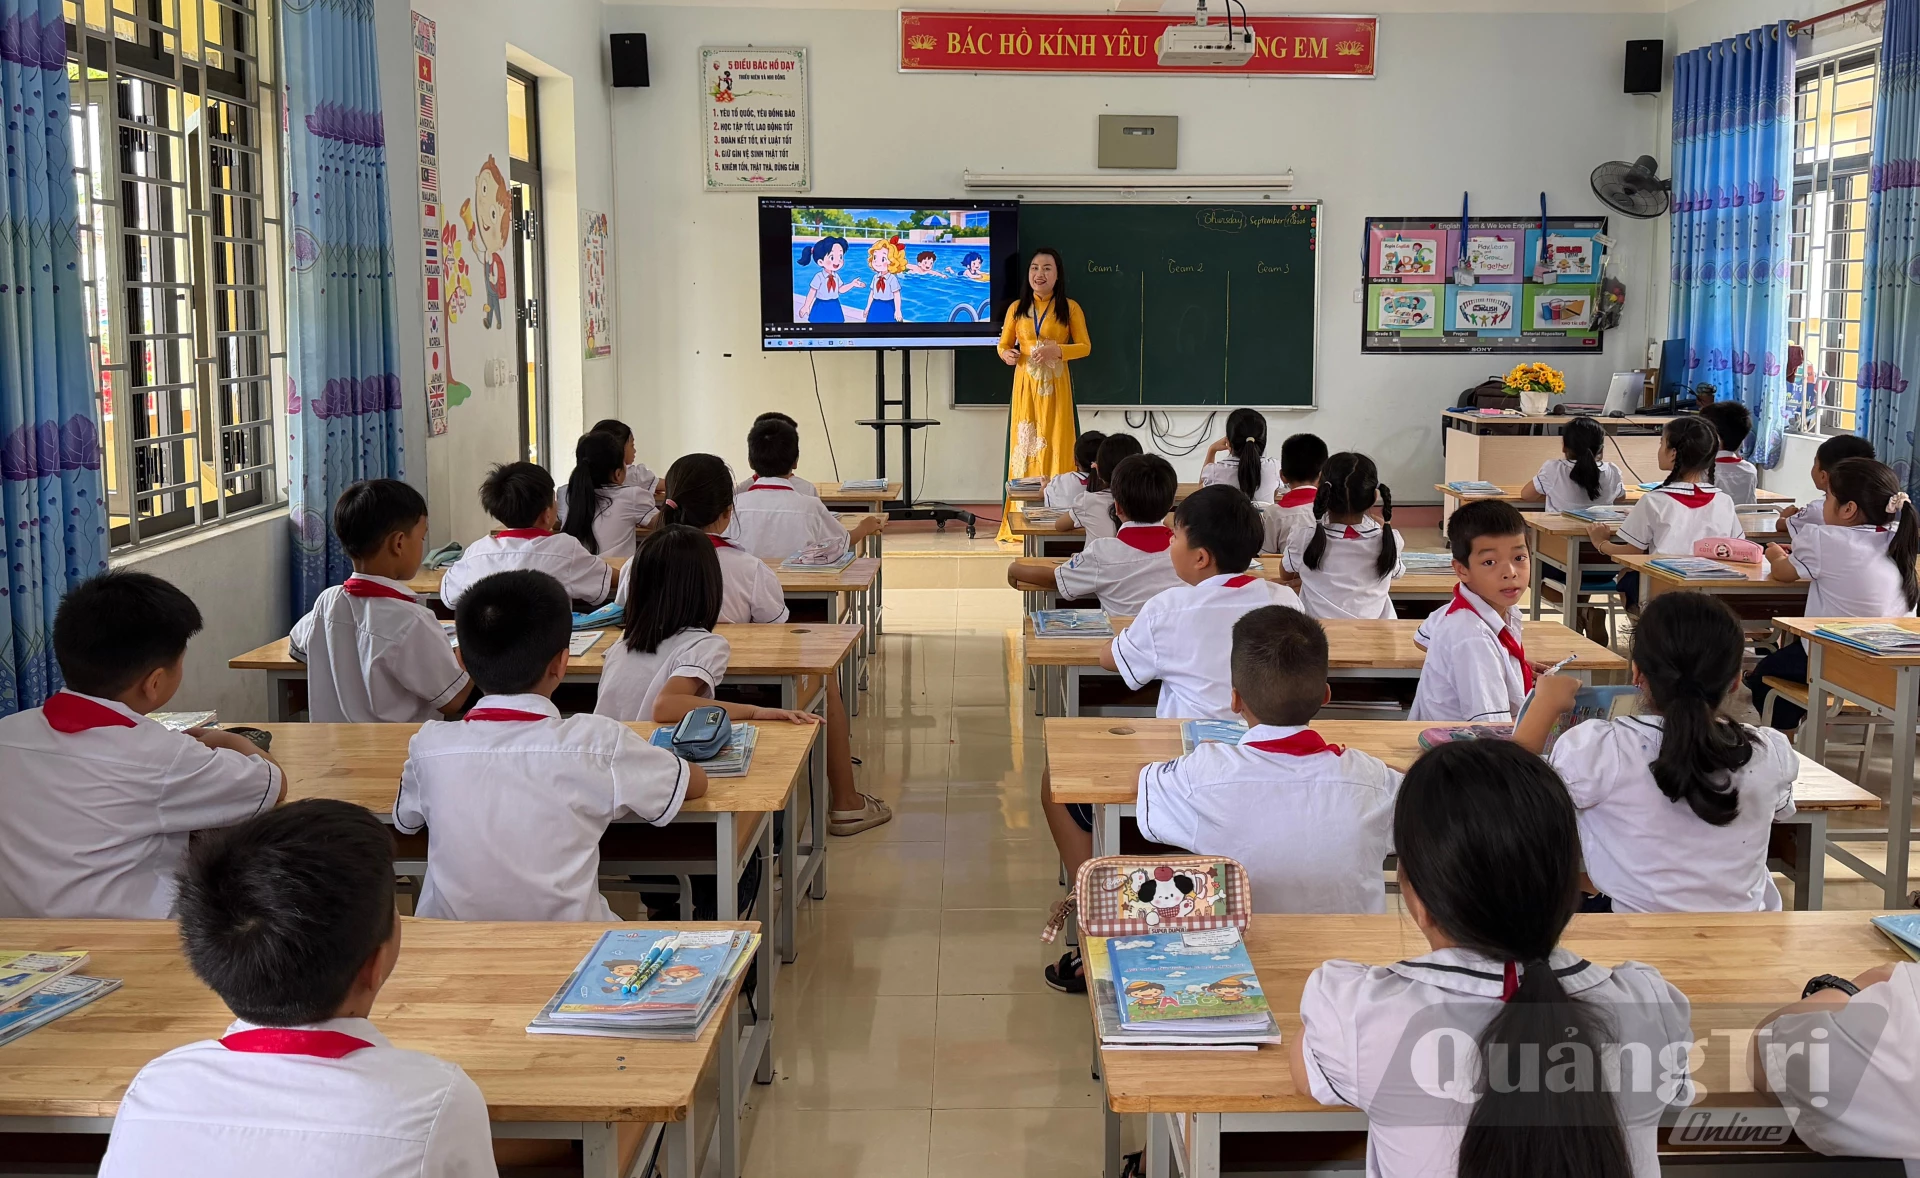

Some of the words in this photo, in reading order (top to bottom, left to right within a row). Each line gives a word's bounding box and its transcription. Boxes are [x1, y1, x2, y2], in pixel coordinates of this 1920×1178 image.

[947, 26, 992, 54] BÁC
[999, 27, 1032, 55] HỒ
[1038, 27, 1096, 56] KÍNH
[1102, 27, 1148, 57] YÊU
[1293, 37, 1328, 59] EM
[728, 61, 733, 70] 5
[734, 58, 751, 70] ĐIỀU
[753, 59, 768, 70] BÁC
[780, 61, 795, 72] DẠY
[713, 108, 719, 117] 1.
[720, 108, 730, 117] YÊU
[757, 108, 767, 117] YÊU
[713, 121, 719, 131] 2.
[720, 123, 731, 132] HỌC
[733, 122, 743, 132] TẬP
[756, 123, 766, 131] LAO
[714, 135, 720, 144] 3.
[737, 134, 747, 144] KẾT
[768, 135, 781, 146] LUẬT
[714, 149, 720, 158] 4.
[750, 150, 764, 158] SINH
[765, 149, 778, 159] THẬT
[714, 162, 720, 171] 5.
[1204, 211, 1243, 229] Thursday
[1250, 214, 1284, 228] September
[1438, 222, 1460, 230] English
[1513, 222, 1535, 230] English
[1088, 260, 1113, 273] Team
[1115, 264, 1120, 272] 1
[1168, 258, 1194, 273] Team
[1197, 262, 1204, 272] 2
[1257, 260, 1282, 273] Team
[1283, 263, 1290, 273] 3
[427, 300, 440, 311] CHINA
